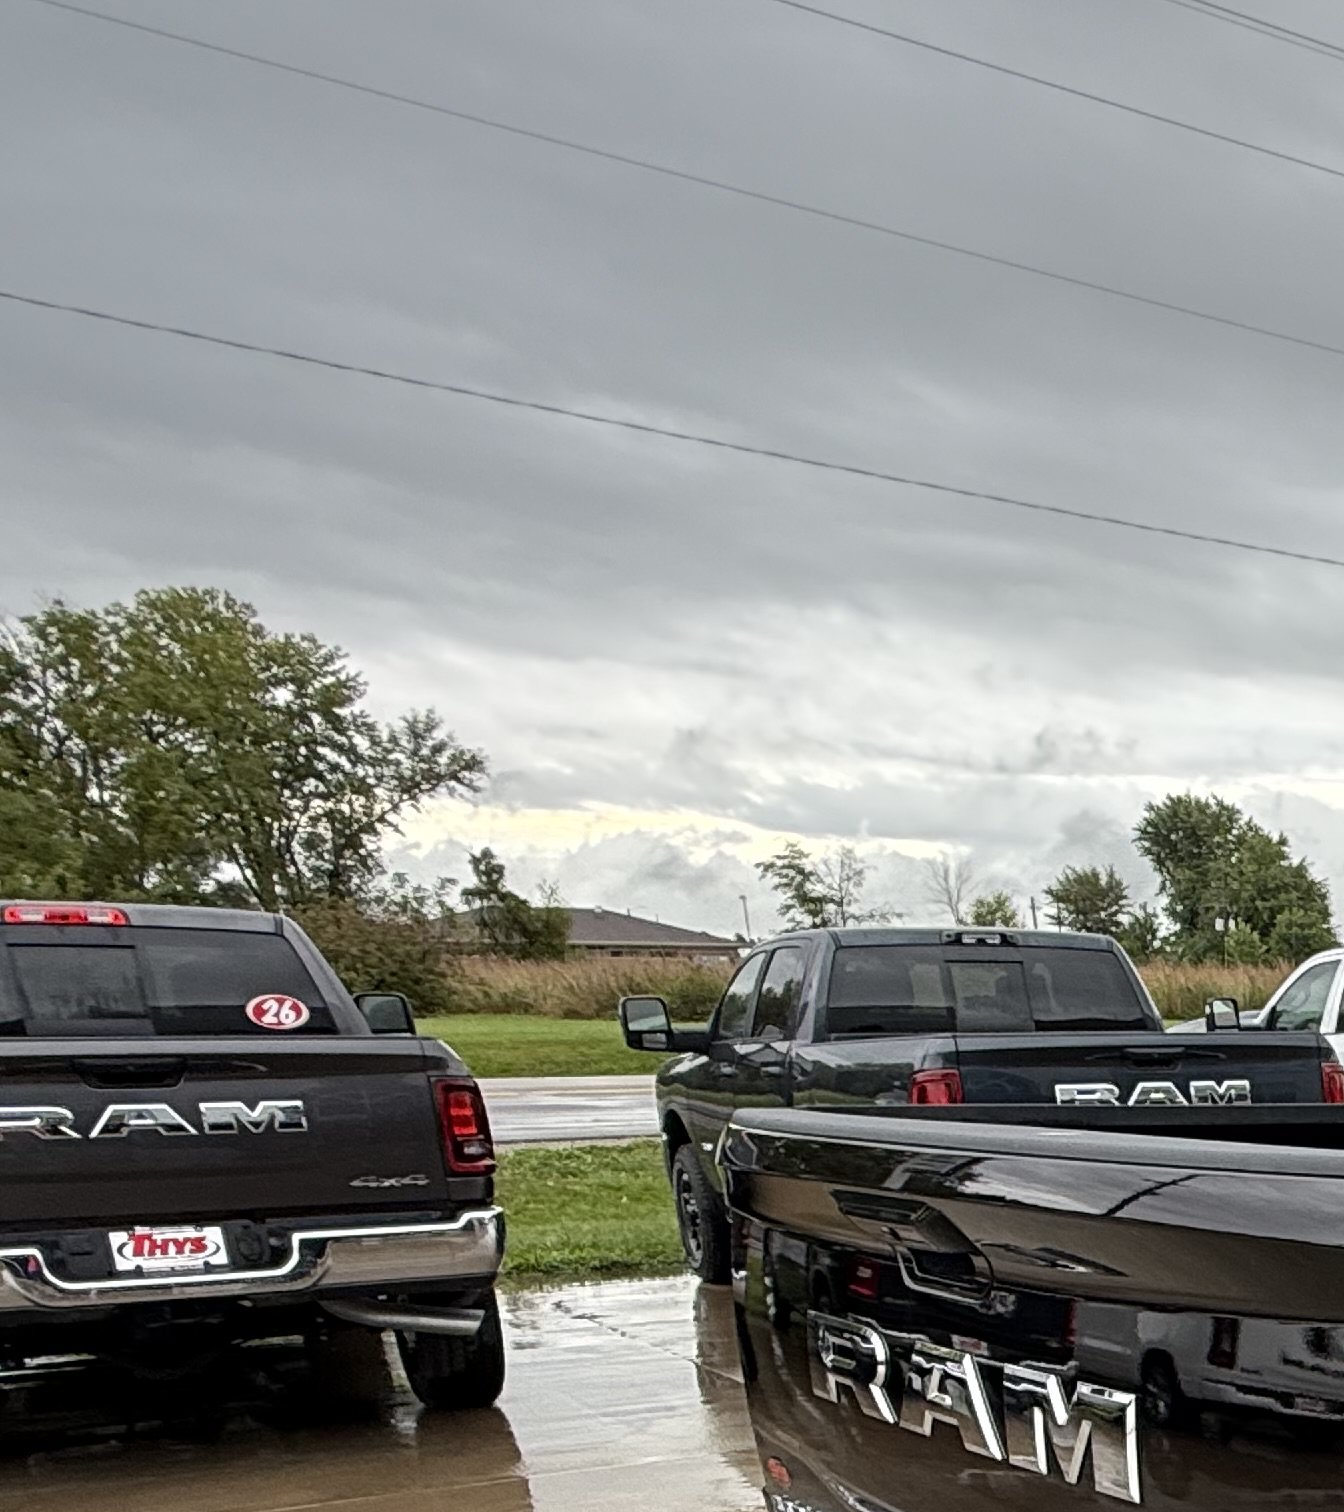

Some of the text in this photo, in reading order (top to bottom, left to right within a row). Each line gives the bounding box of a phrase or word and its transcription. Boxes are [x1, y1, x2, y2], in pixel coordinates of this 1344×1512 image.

[260, 998, 297, 1025] 26
[1055, 1079, 1251, 1106] RAM
[0, 1100, 308, 1140] RAM
[128, 1230, 208, 1258] THYS
[806, 1310, 1142, 1504] RAM
